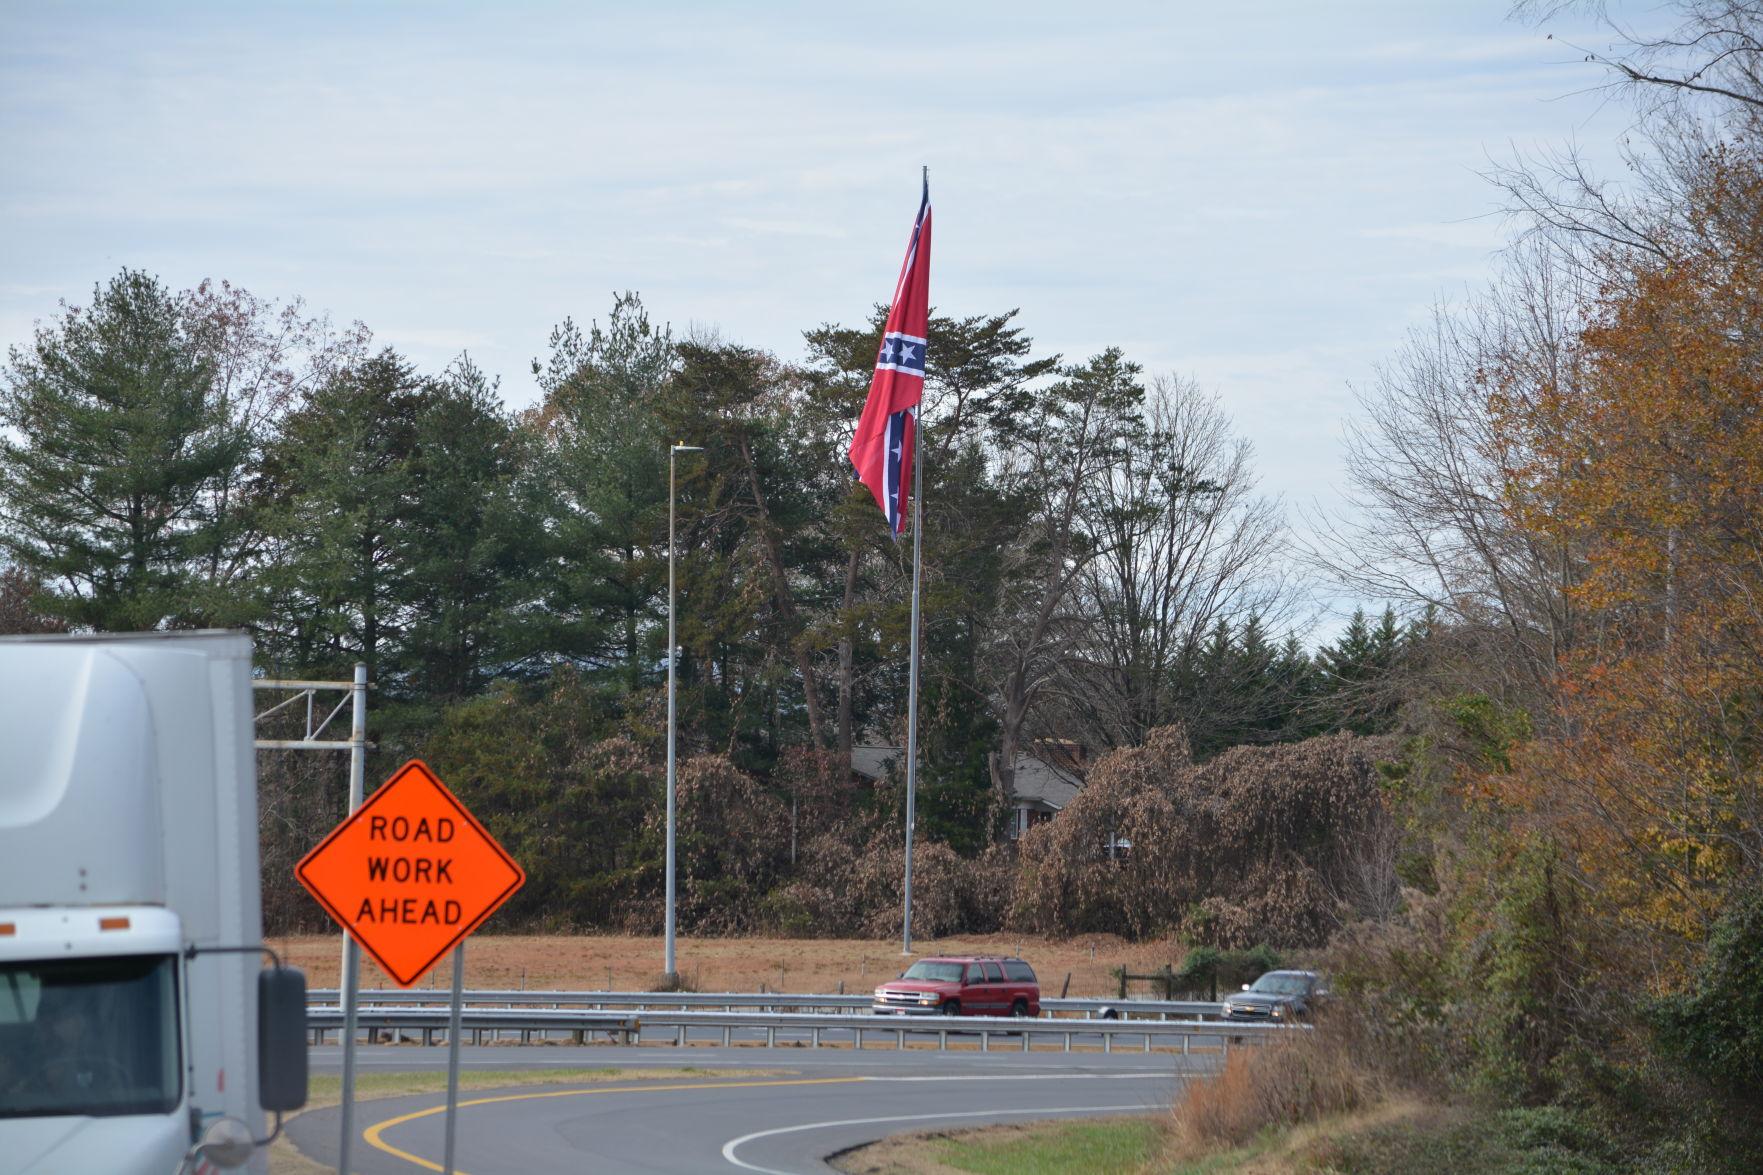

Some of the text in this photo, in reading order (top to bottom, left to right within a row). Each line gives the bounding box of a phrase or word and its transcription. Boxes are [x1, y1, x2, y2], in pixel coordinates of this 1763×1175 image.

[370, 815, 455, 842] ROAD
[368, 857, 452, 884] WORK
[356, 898, 462, 925] AHEAD
